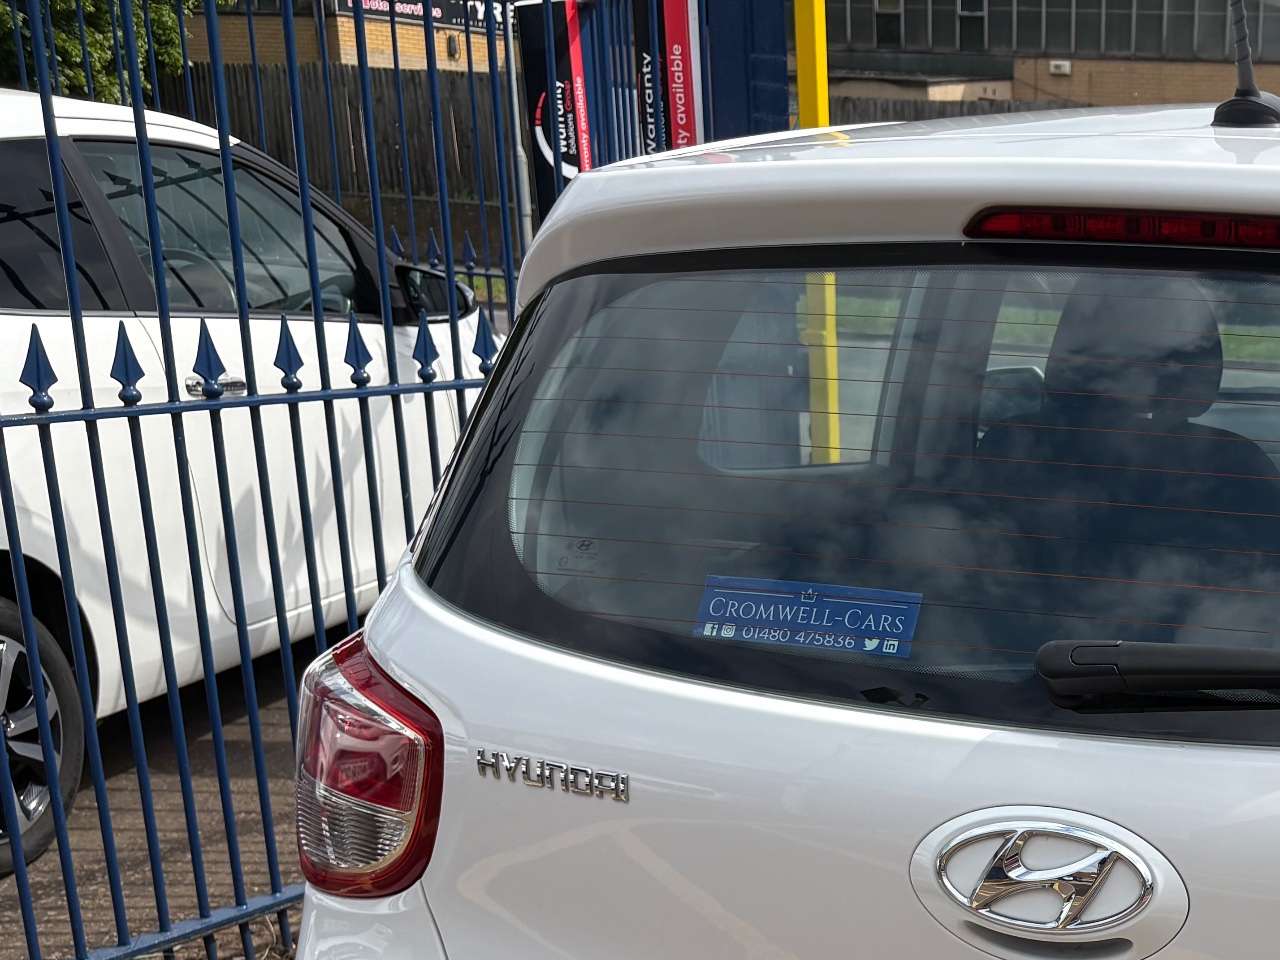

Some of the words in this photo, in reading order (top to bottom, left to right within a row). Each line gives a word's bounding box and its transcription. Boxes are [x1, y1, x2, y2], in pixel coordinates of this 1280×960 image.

[575, 76, 587, 130] available
[671, 44, 686, 125] available
[742, 627, 791, 642] 01480
[794, 631, 855, 649] 475836
[476, 748, 630, 804] HYUNDAI
